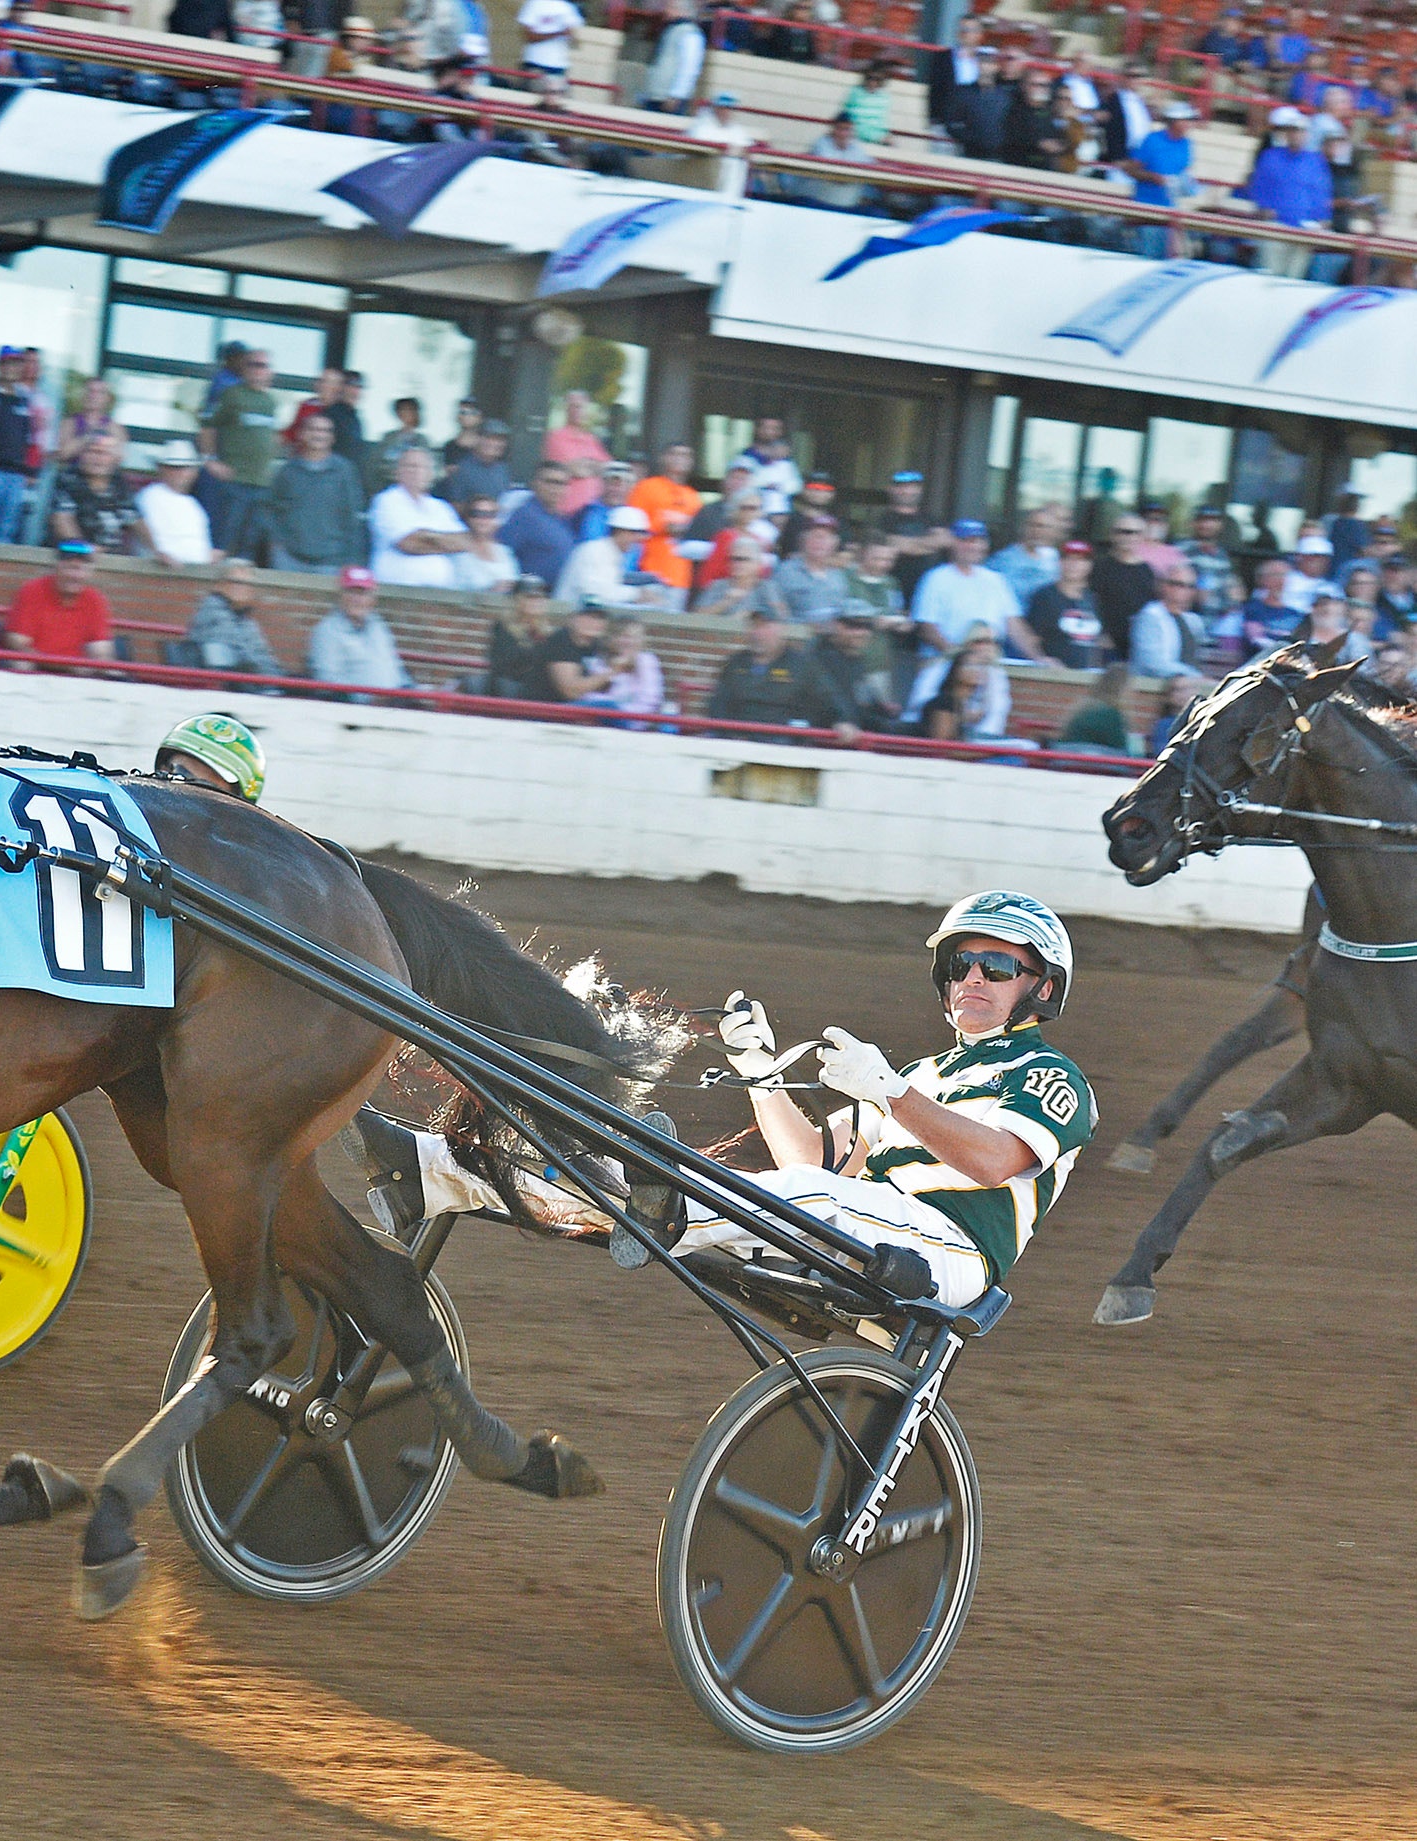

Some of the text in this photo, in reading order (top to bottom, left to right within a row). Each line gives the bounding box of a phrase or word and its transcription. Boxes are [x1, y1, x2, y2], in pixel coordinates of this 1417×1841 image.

[9, 779, 145, 988] 11
[1020, 1066, 1080, 1127] YG
[844, 1331, 965, 1555] TAKTER
